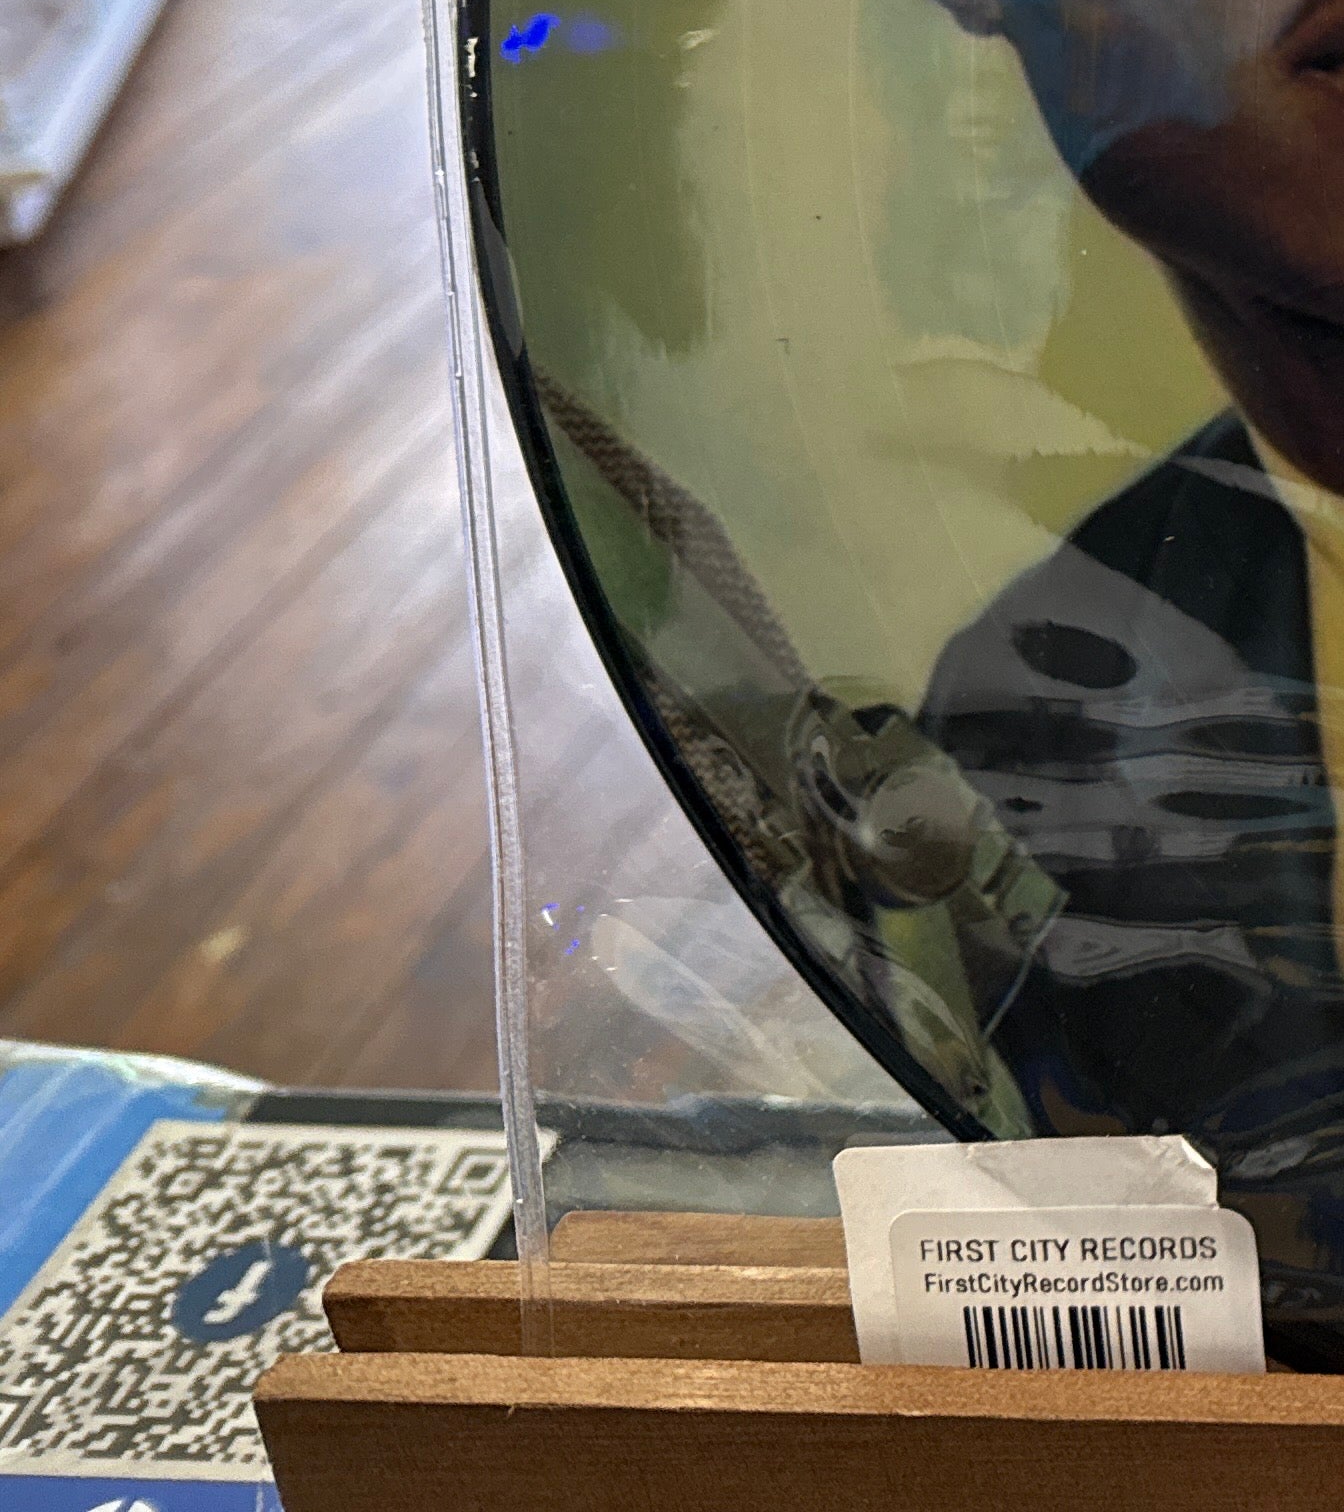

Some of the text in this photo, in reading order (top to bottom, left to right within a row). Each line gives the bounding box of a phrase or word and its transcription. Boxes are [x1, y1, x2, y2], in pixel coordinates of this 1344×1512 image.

[919, 1236, 1218, 1263] FIRST CITY RECORDS
[924, 1271, 1225, 1299] FirstCityRecordStore.com
